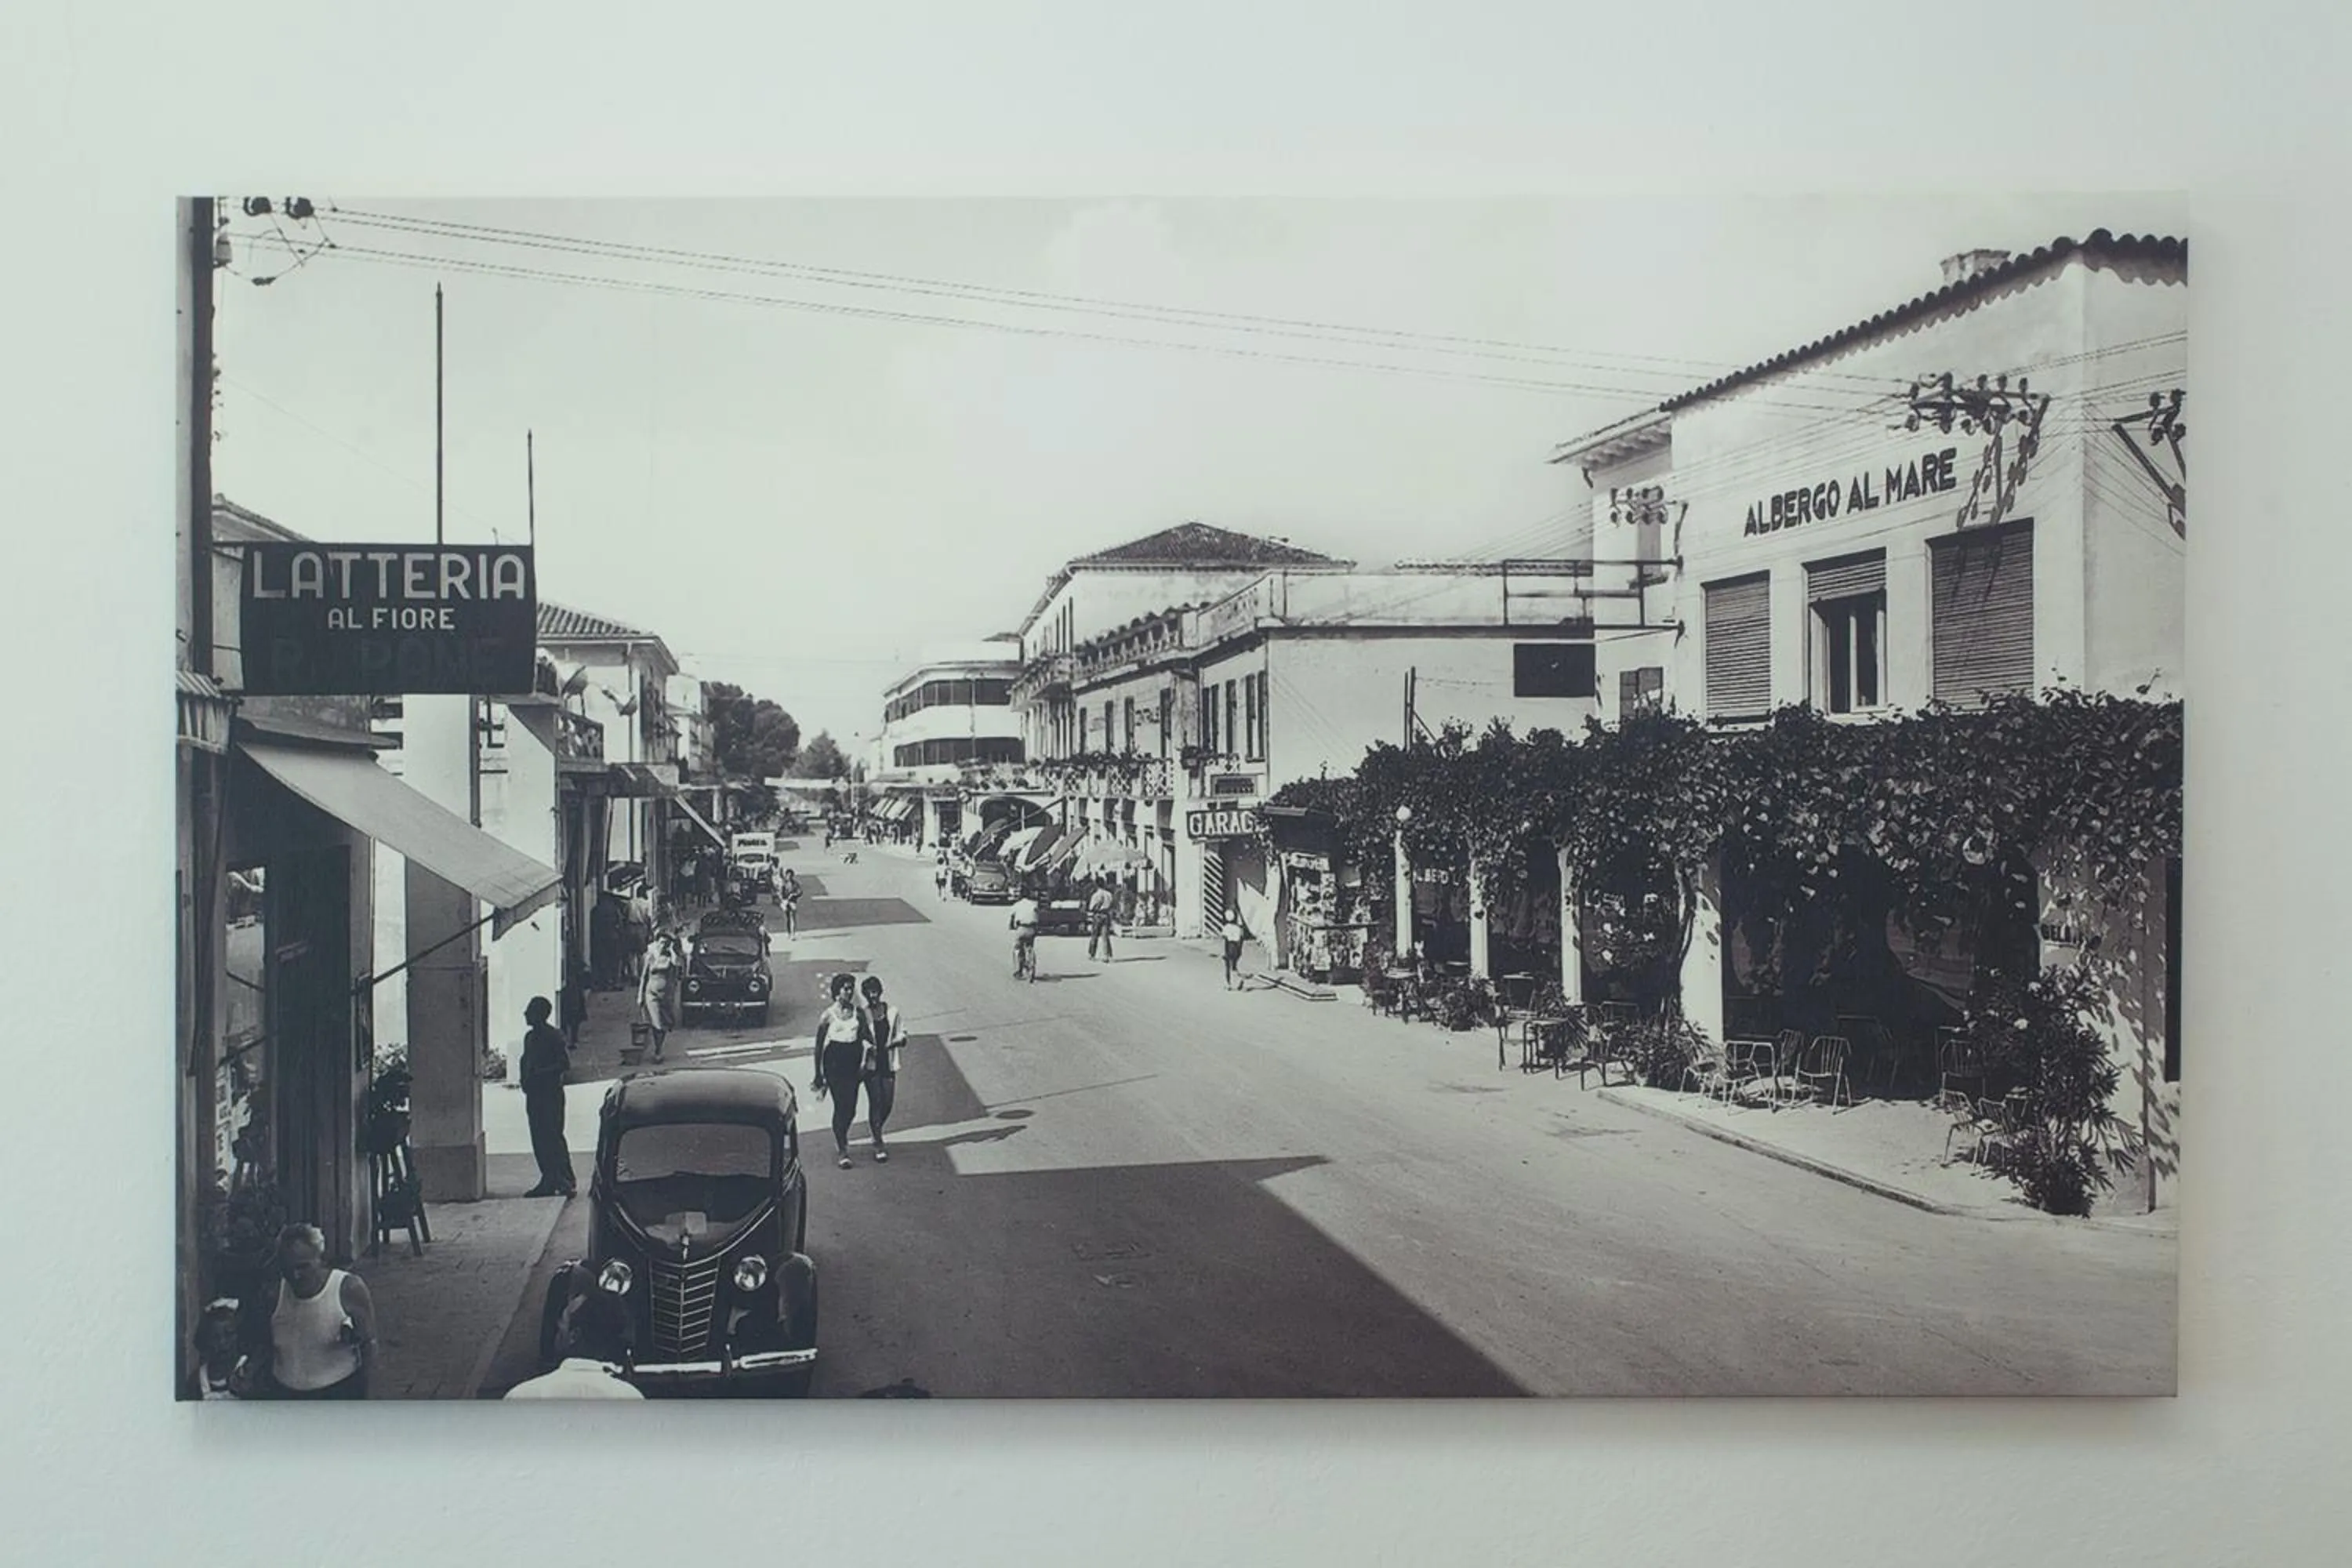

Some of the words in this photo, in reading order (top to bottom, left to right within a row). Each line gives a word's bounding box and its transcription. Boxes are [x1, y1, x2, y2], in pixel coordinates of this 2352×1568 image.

[1744, 478, 1841, 538] ALBERGO
[1846, 470, 1880, 514] AL
[1886, 447, 1957, 506] MARE
[252, 551, 526, 600] LATTERIA
[328, 608, 363, 630] AL
[372, 608, 456, 630] FIORE
